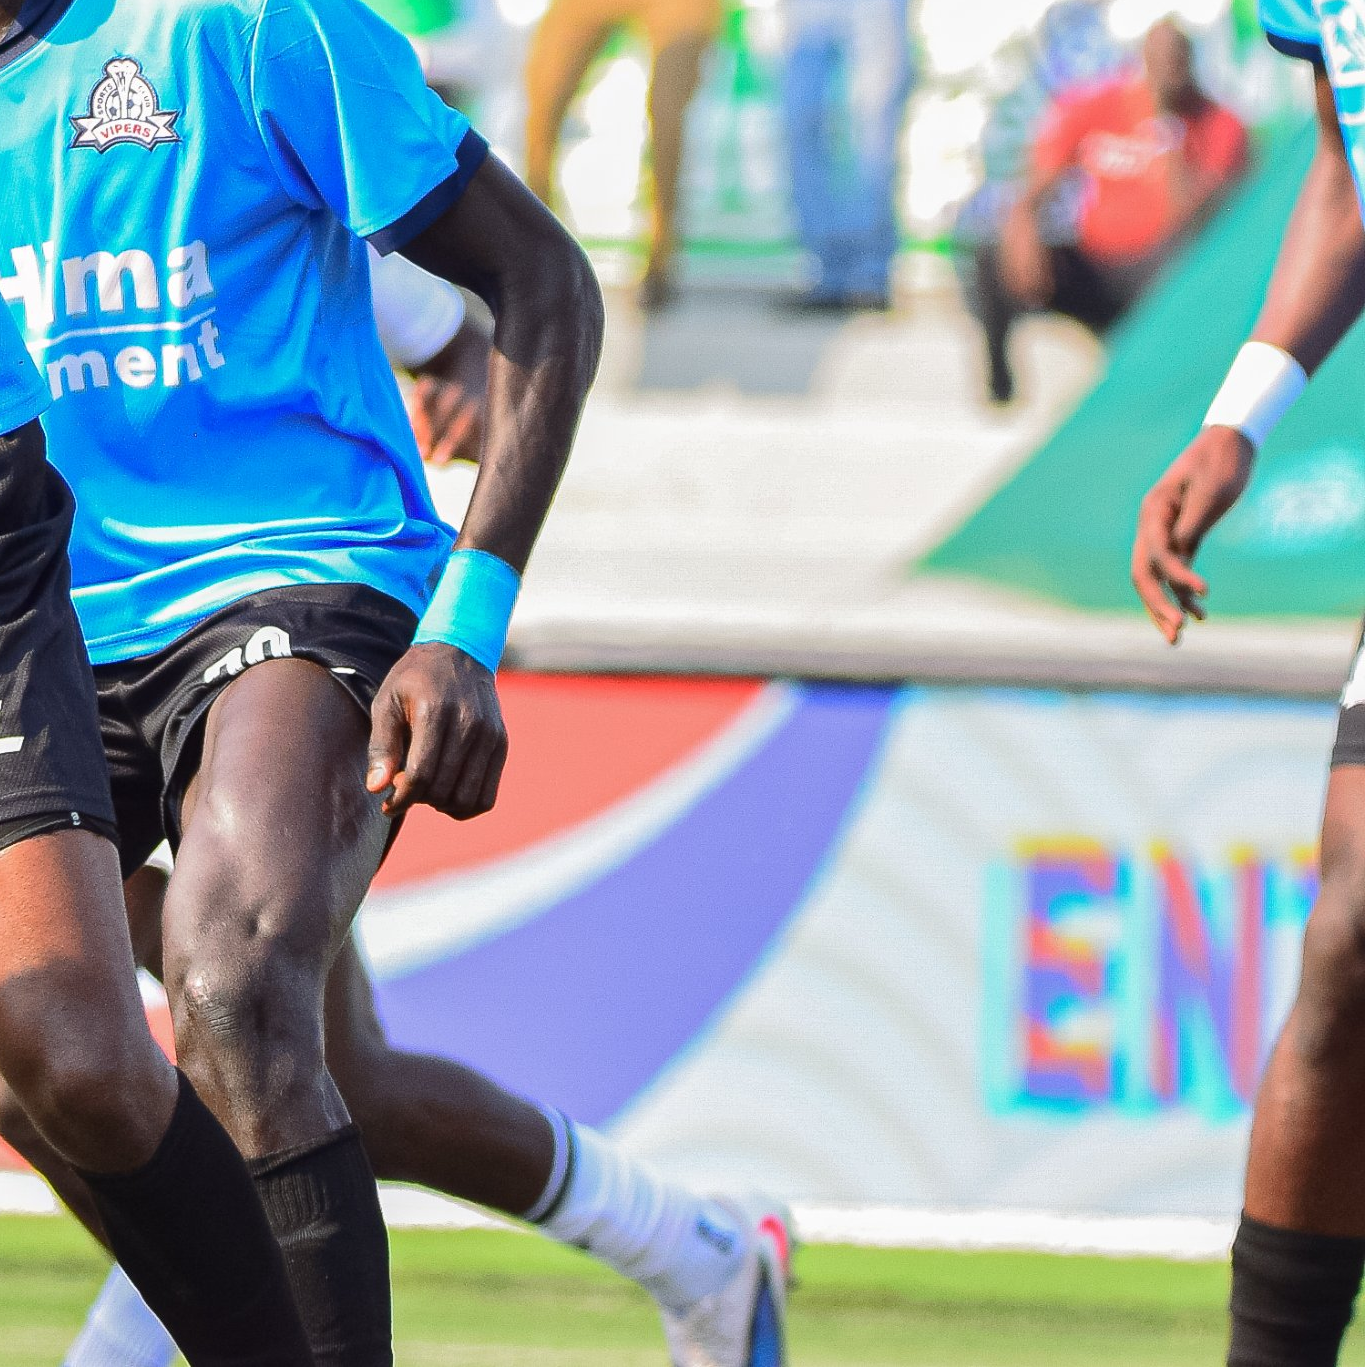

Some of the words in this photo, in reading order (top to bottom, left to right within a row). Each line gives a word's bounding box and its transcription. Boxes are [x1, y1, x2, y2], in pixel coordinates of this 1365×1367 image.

[97, 82, 114, 115] SPORTS
[100, 123, 151, 139] VIPERS
[47, 319, 226, 401] ment
